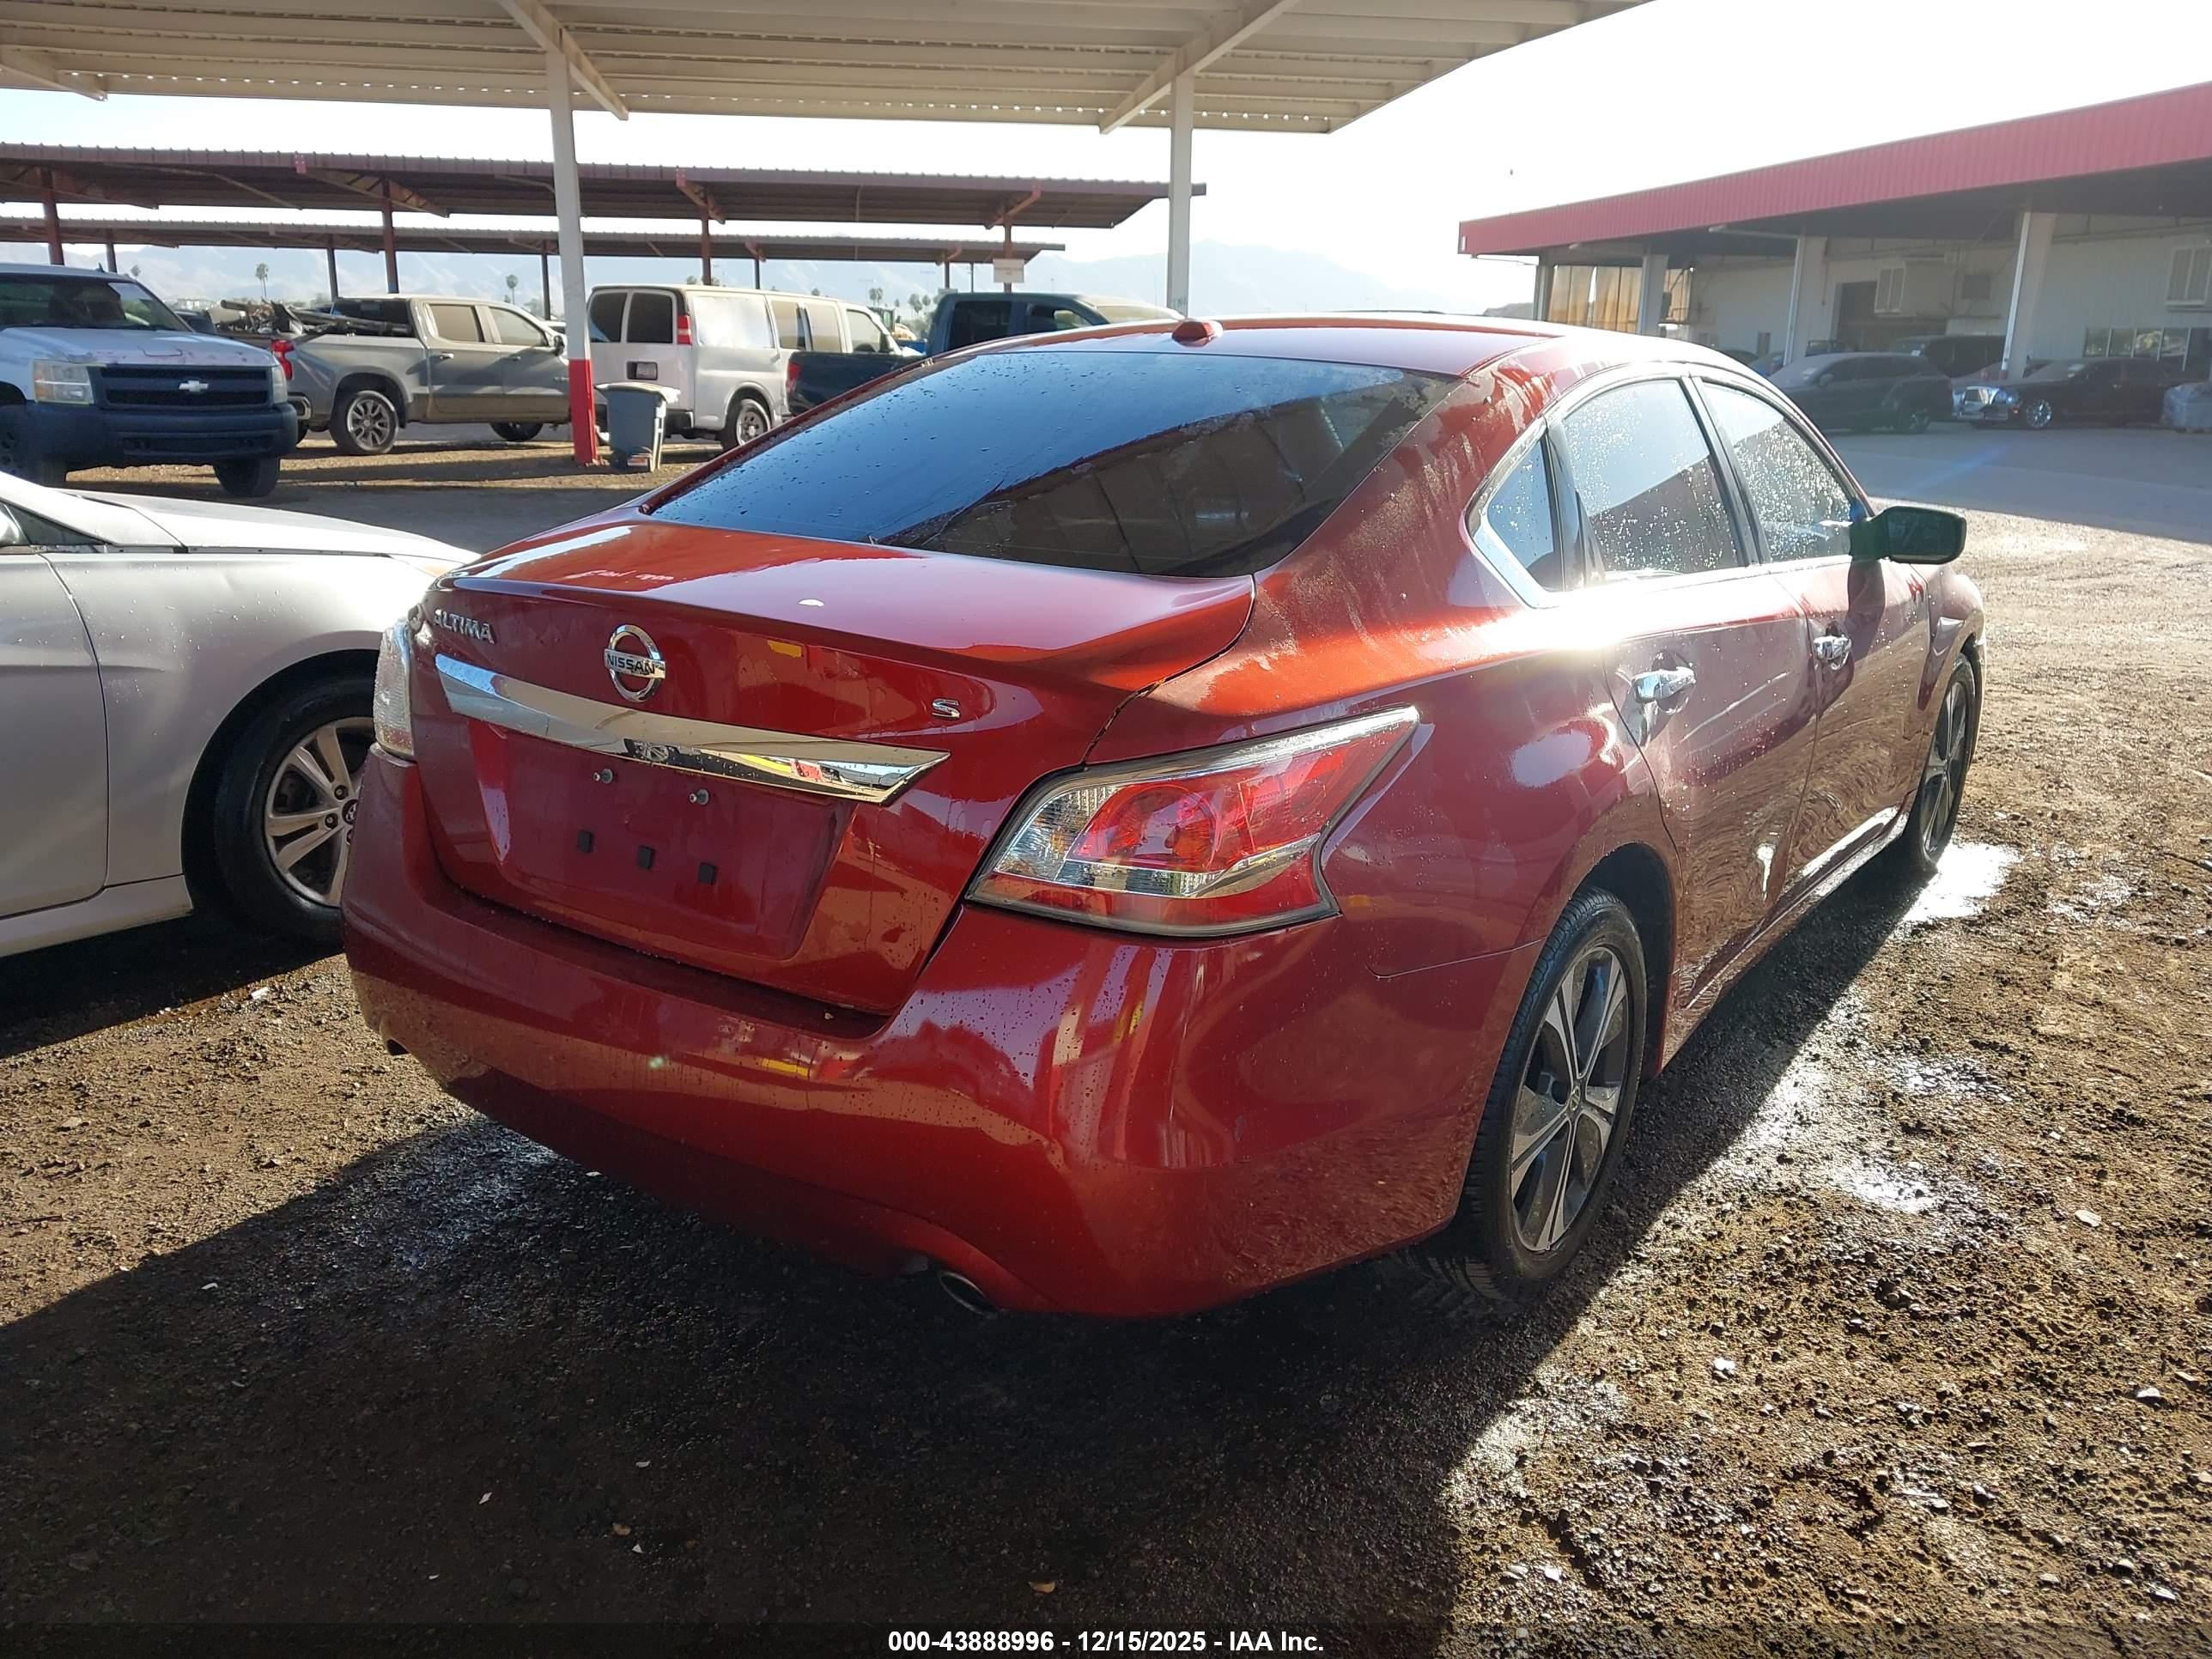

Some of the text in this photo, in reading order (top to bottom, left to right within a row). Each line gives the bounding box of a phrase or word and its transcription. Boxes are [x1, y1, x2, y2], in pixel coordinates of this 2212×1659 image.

[433, 609, 495, 645] ALTIMA
[606, 653, 656, 676] NISSAN
[932, 698, 960, 719] S
